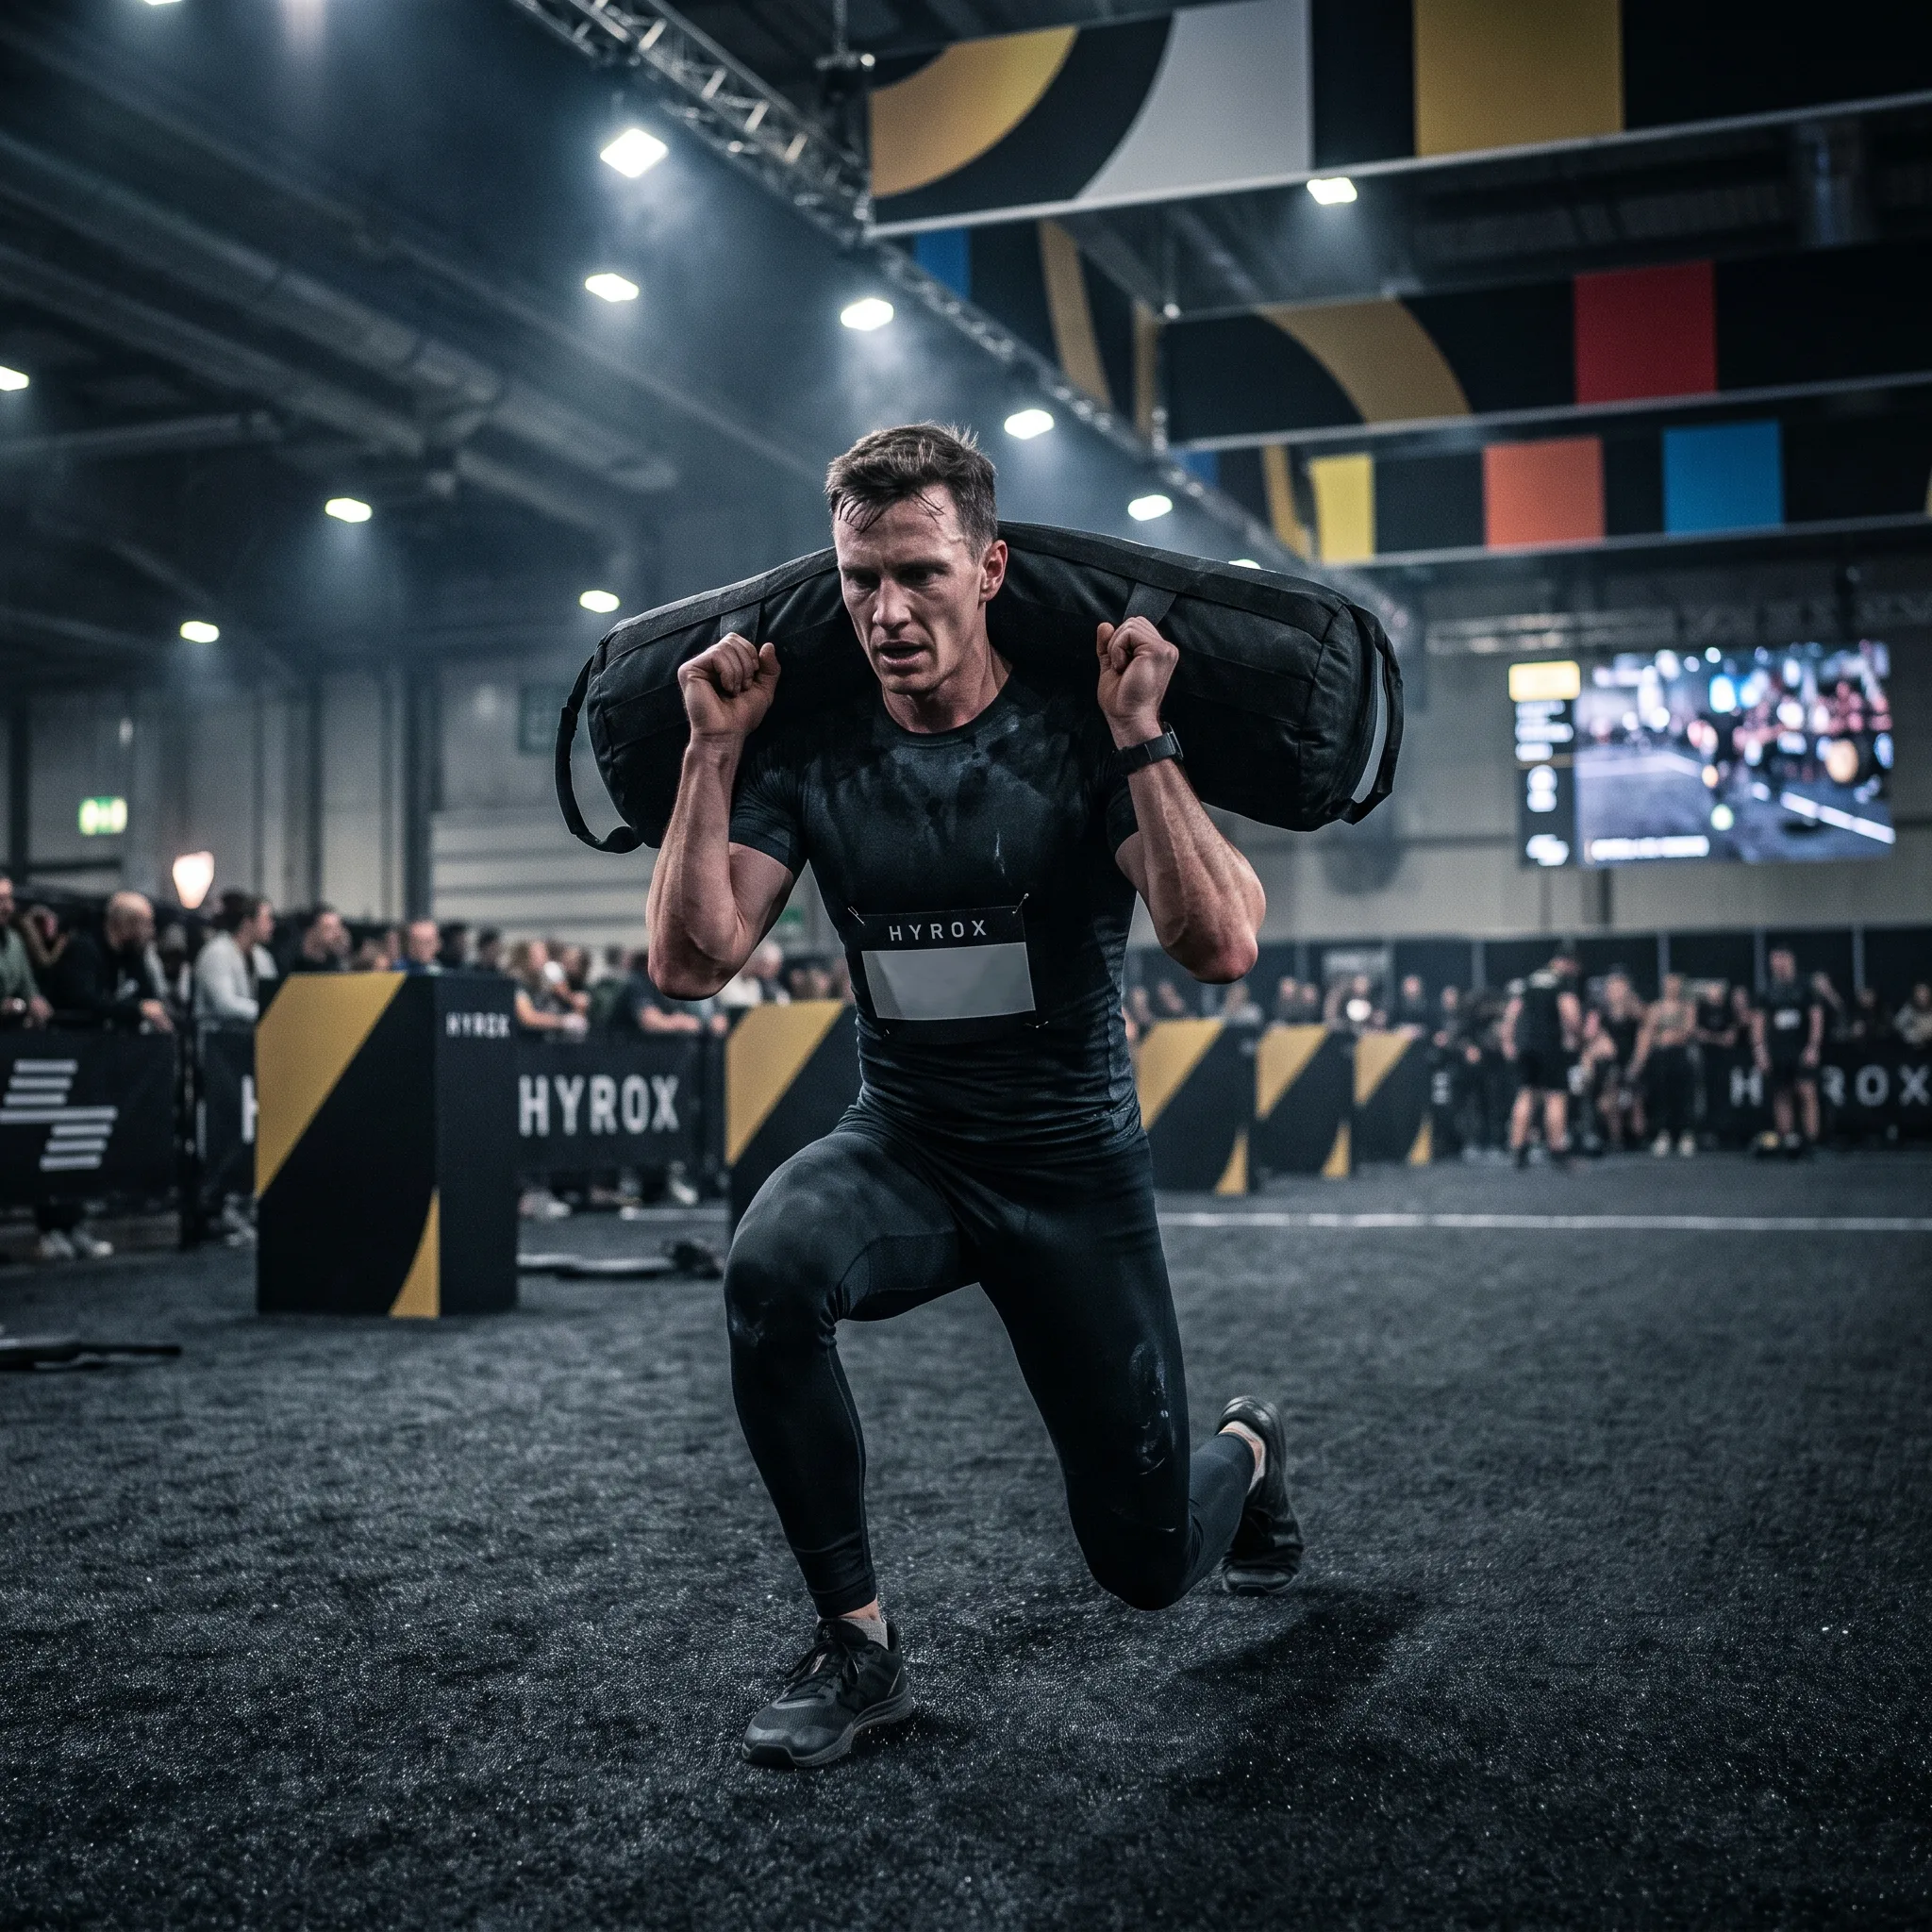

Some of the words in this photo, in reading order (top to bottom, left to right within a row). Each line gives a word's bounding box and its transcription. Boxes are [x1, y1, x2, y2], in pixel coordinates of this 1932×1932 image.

[889, 920, 987, 941] HYROX
[519, 1074, 679, 1137] HYROX
[1729, 1064, 1931, 1108] HROX
